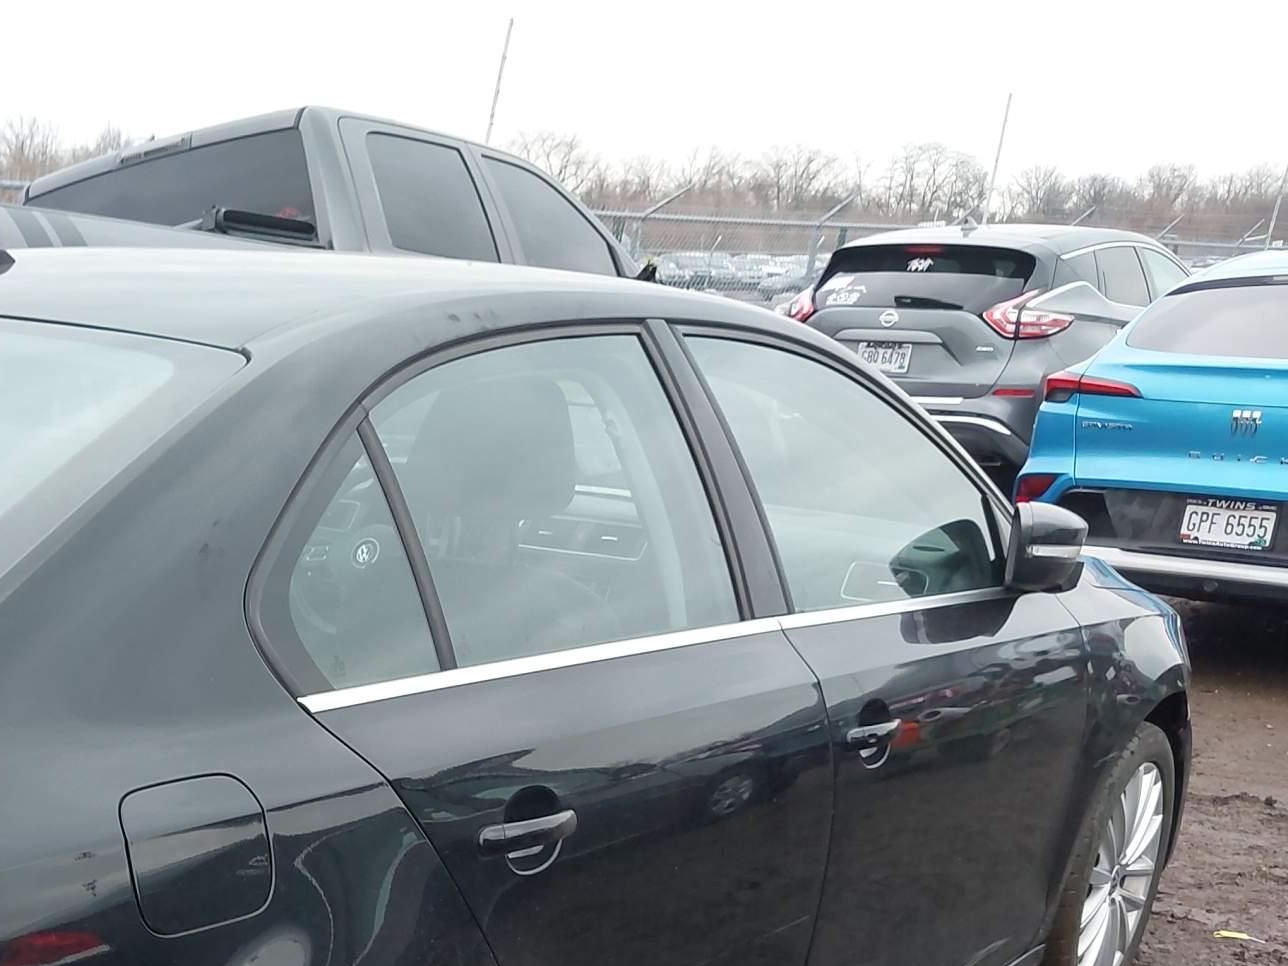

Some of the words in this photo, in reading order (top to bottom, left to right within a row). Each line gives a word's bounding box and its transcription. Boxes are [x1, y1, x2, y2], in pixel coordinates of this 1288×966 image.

[881, 350, 906, 366] 6478
[1207, 498, 1257, 511] TWINS
[1186, 510, 1221, 534] GPF
[1224, 513, 1271, 539] 6555
